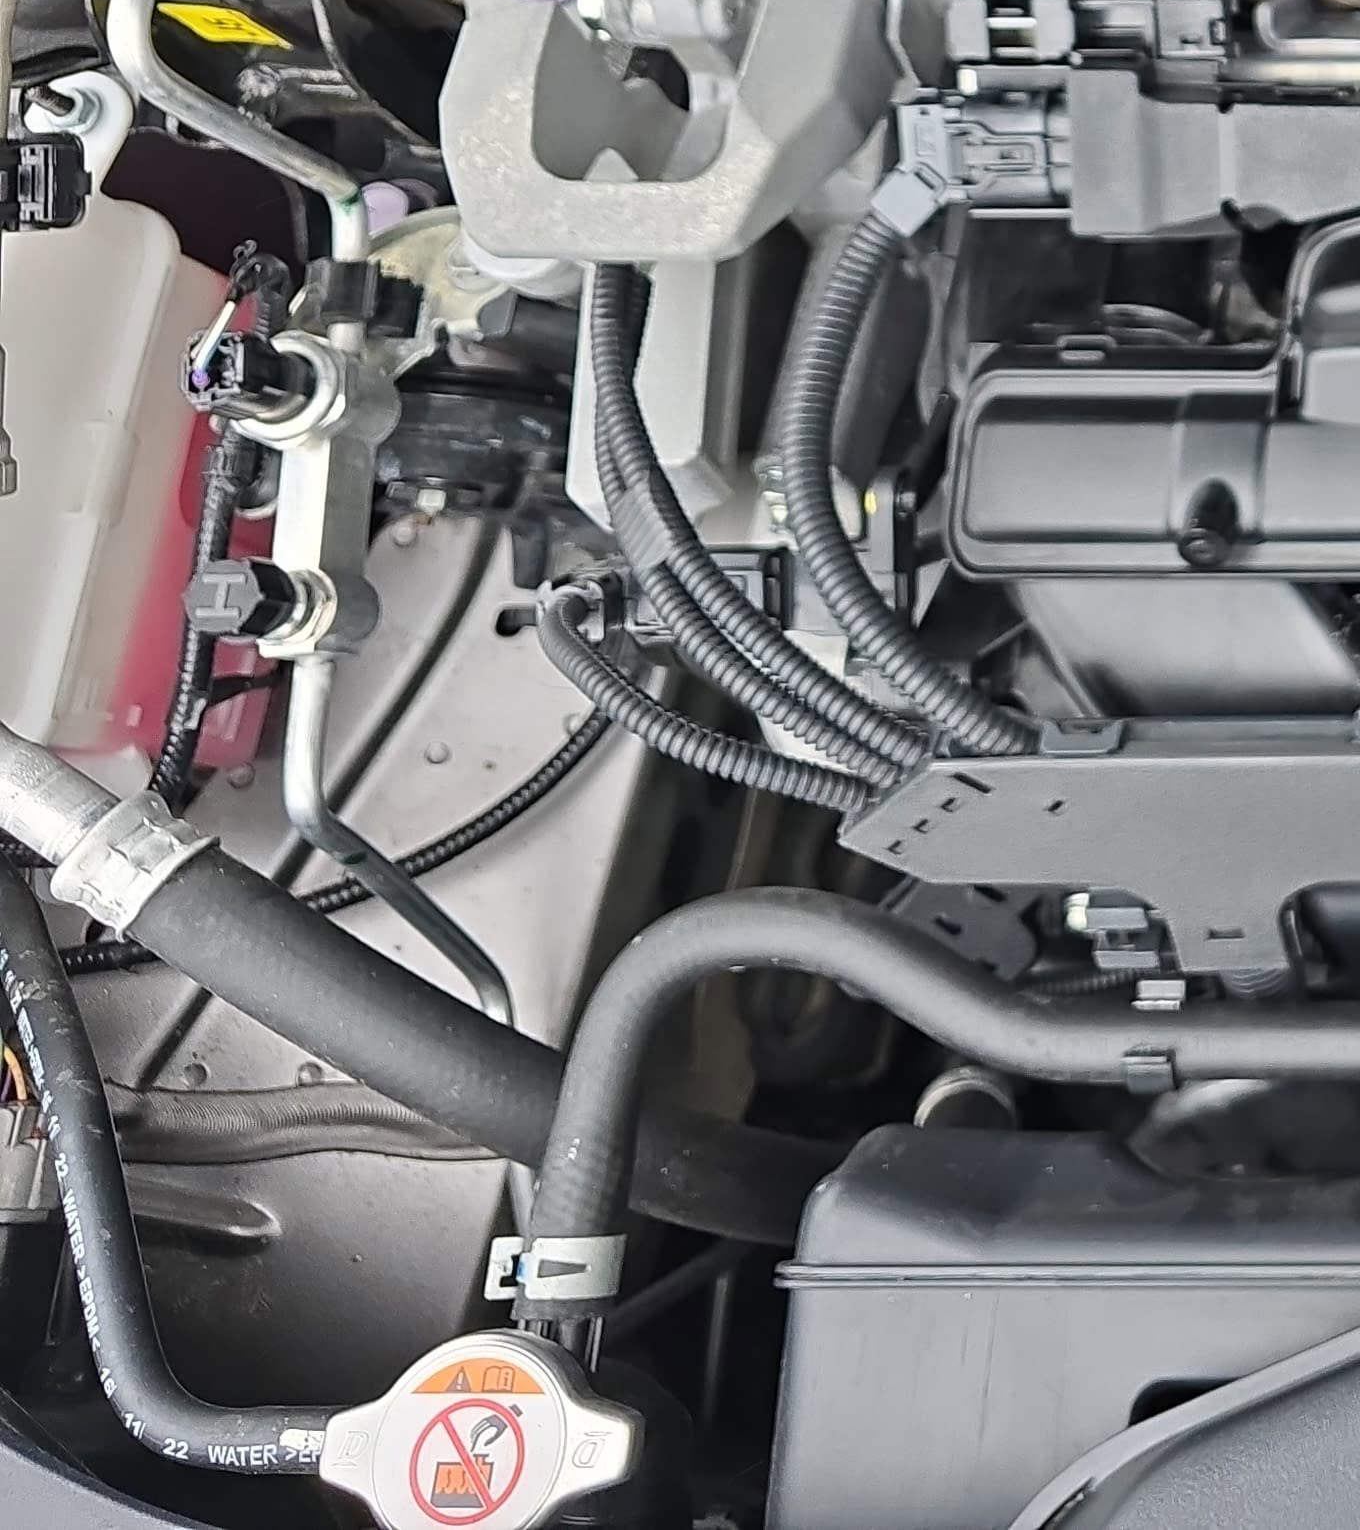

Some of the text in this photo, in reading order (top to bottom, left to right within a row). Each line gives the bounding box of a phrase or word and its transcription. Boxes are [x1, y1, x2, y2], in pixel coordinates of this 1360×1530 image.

[62, 1188, 85, 1263] WATER
[163, 1438, 190, 1460] 22
[207, 1444, 279, 1468] WATER
